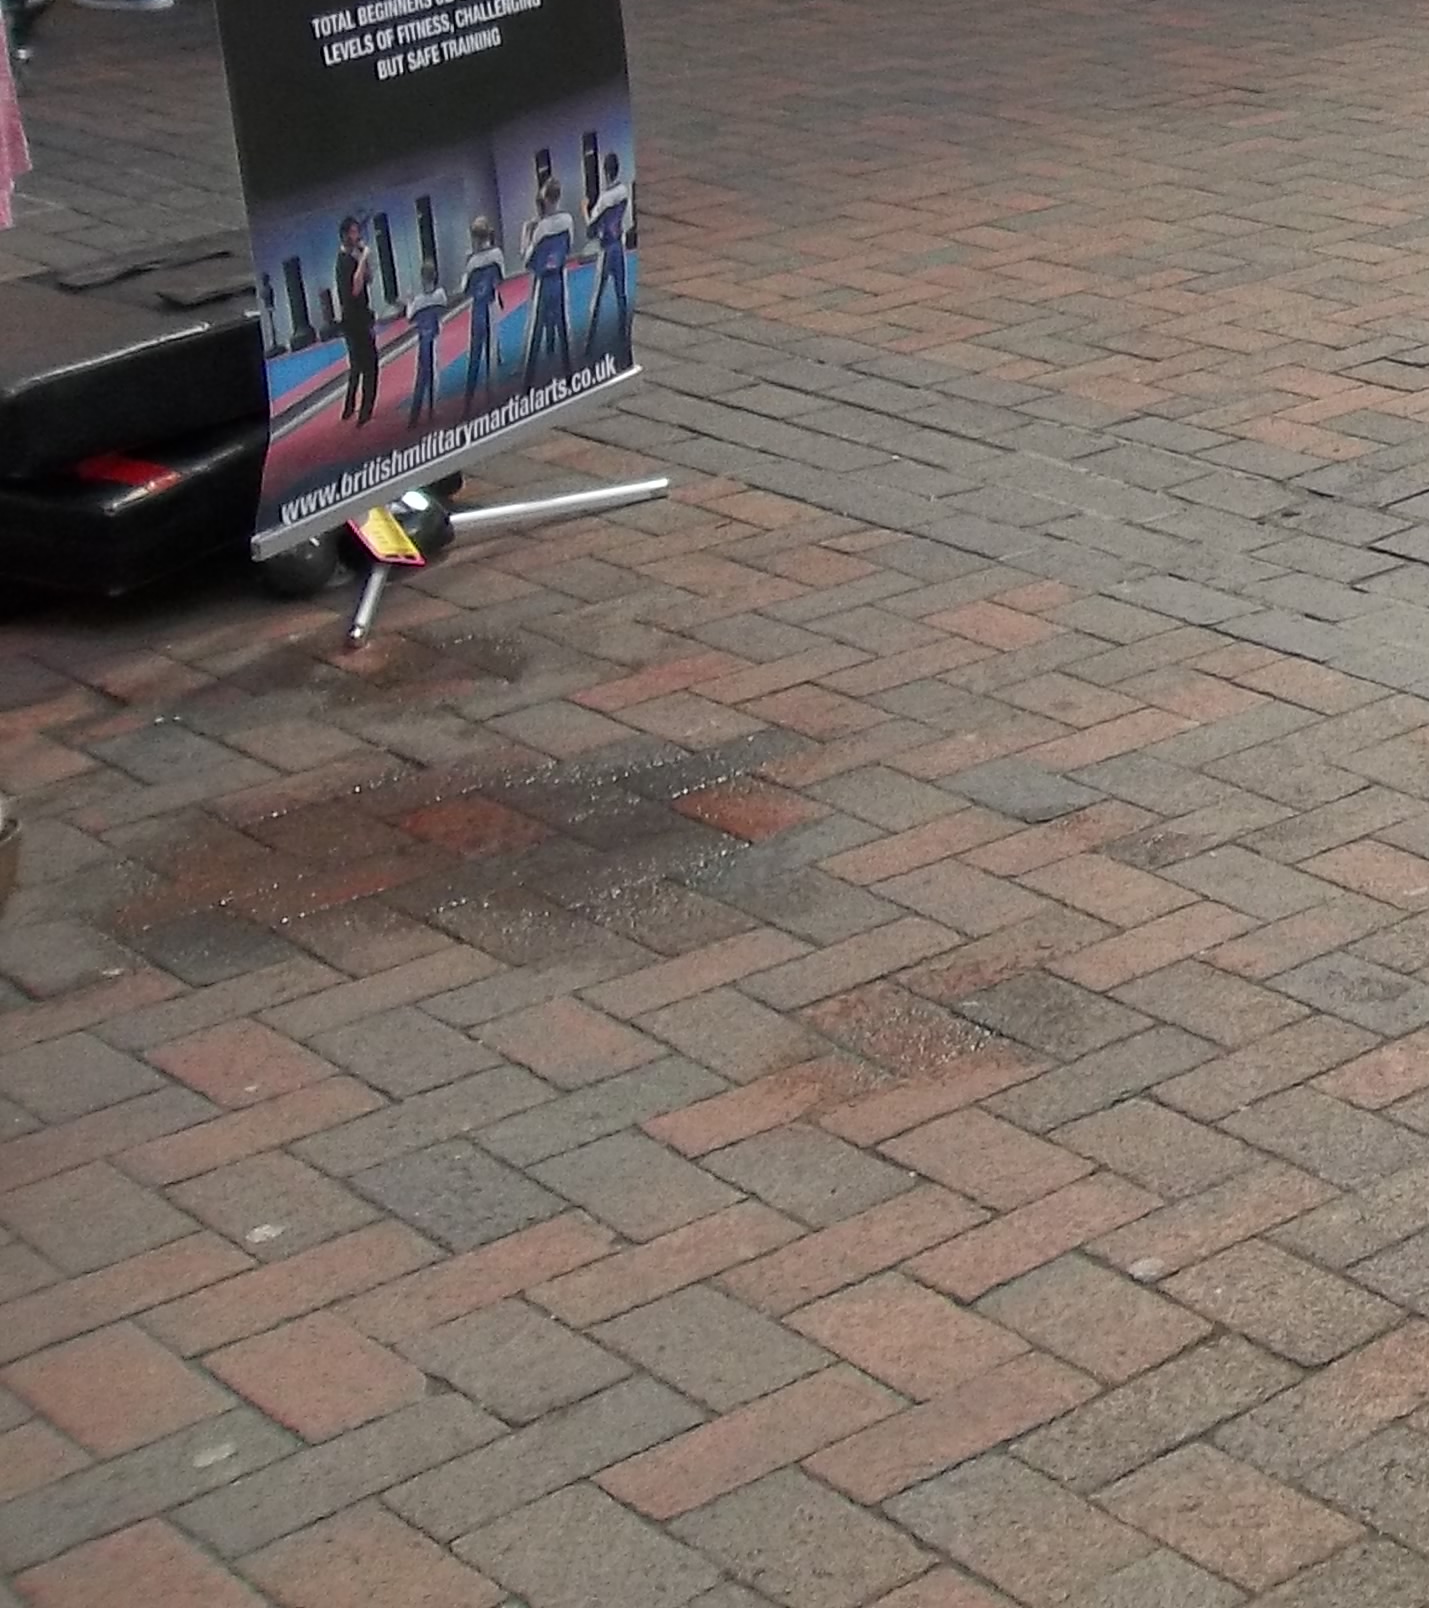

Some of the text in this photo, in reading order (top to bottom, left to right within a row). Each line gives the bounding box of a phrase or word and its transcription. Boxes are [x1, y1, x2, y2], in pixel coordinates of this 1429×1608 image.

[312, 9, 356, 39] TOTAL
[323, 35, 374, 67] LEVELS
[377, 29, 396, 51] OF
[397, 13, 455, 44] FITNESS,
[377, 28, 502, 80] BUT SAFE TRAINING
[279, 353, 617, 526] www.britishmilitarymartialarts.co.uk
